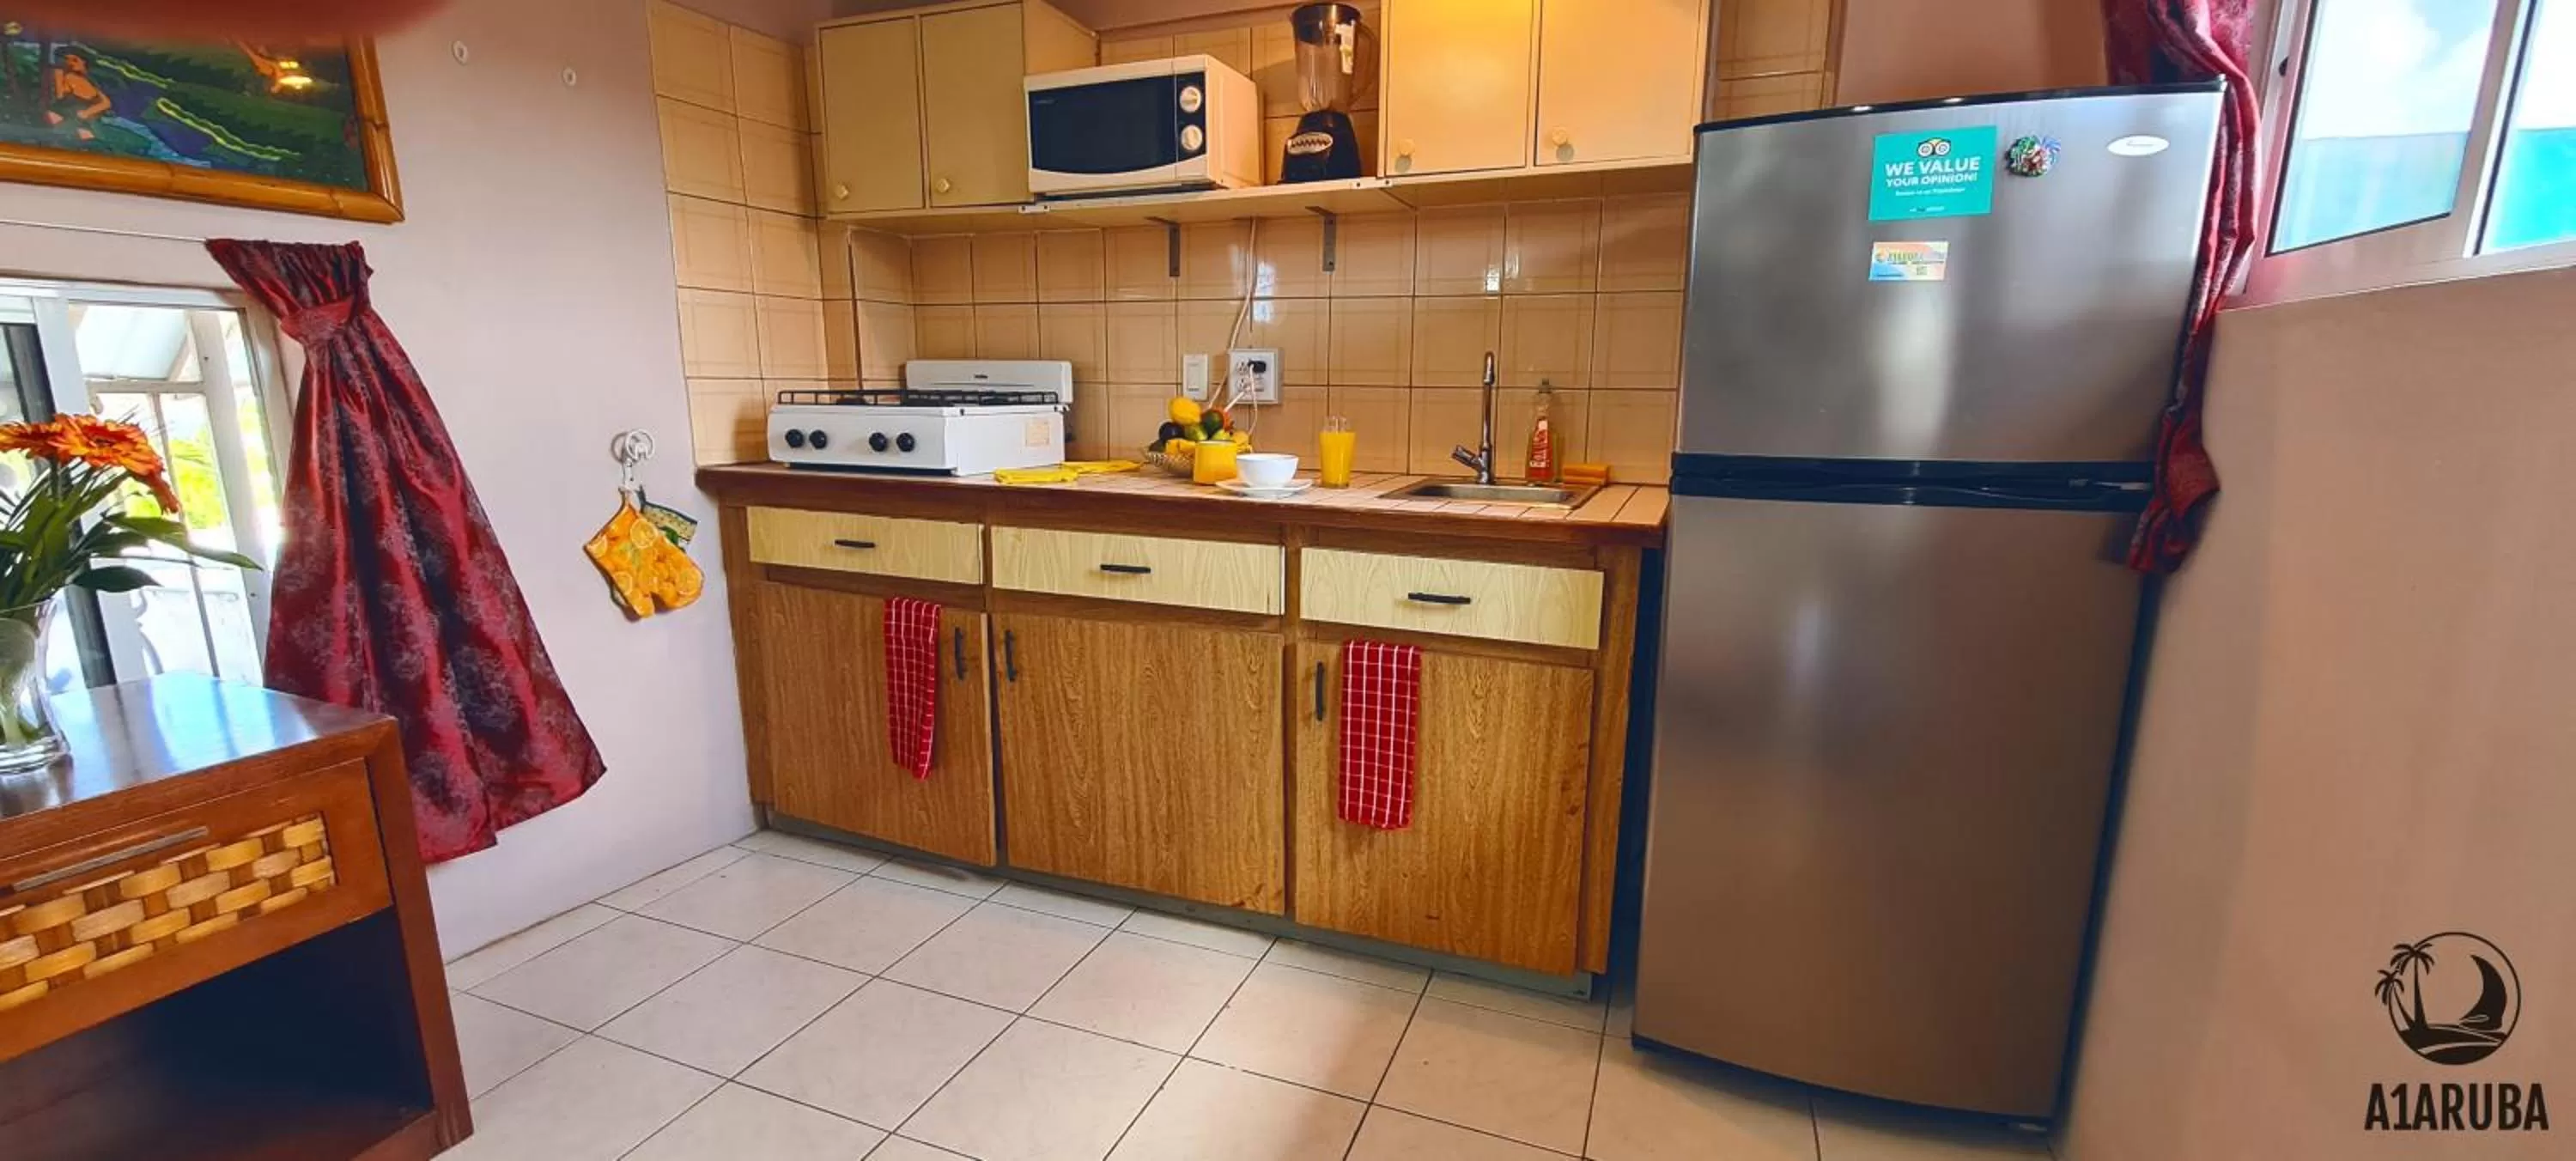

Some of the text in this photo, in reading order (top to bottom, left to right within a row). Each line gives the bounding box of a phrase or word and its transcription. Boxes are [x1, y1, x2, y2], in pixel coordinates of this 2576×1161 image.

[1885, 155, 1982, 177] WE VALUE
[1886, 172, 1978, 188] YOUR OPINION!
